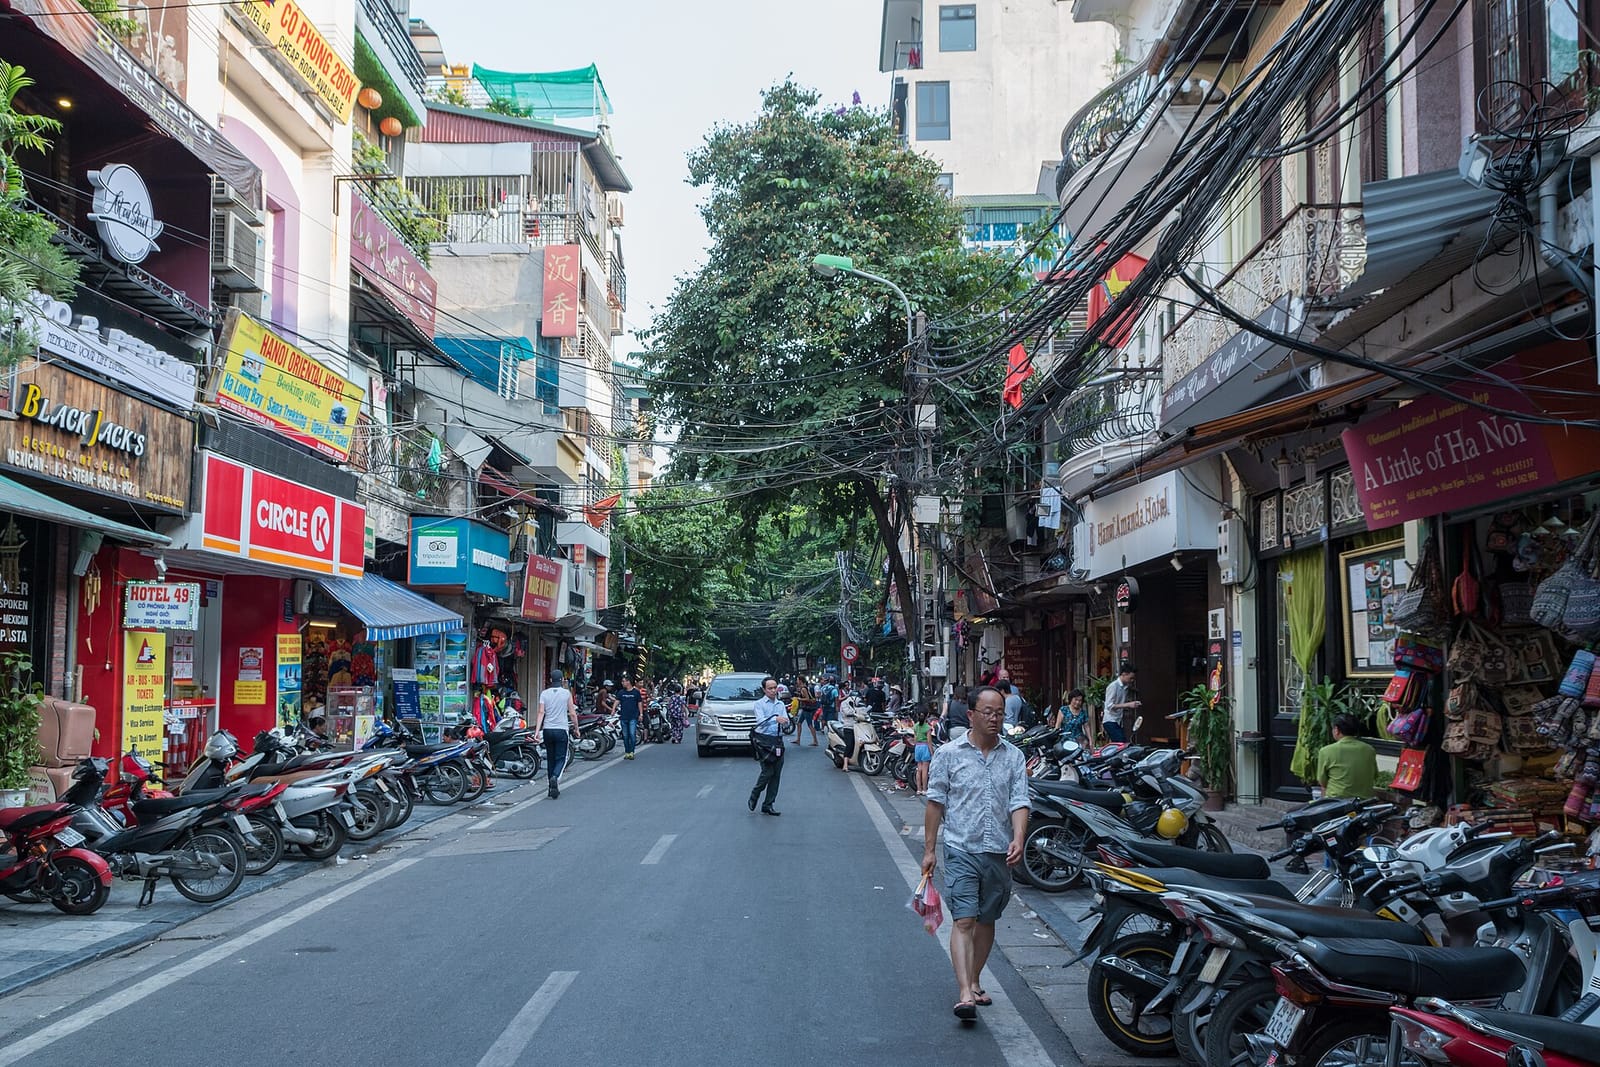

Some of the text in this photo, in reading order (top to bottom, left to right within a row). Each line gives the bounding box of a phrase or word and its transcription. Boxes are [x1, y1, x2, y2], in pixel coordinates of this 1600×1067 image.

[261, 18, 271, 34] 49
[278, 35, 345, 114] CHEAP ROOM AVAILABLE
[330, 62, 357, 103] 260K
[547, 253, 575, 326] 沉香
[260, 334, 345, 402] HANOI ORIENTAL HOTEL
[223, 373, 233, 391] Ha
[234, 380, 251, 401] Long
[250, 386, 264, 408] Bay
[277, 373, 321, 409] Booking office
[21, 383, 146, 457] BLACK JACK'S
[7, 448, 45, 473] MEXICAN
[72, 466, 94, 486] STEAK
[1364, 415, 1527, 491] A Little of Ha Noi
[256, 498, 308, 539] CIRCLE
[1114, 499, 1145, 539] Amanda
[1145, 486, 1171, 525] Hotel
[130, 586, 189, 603] HOTEL 49
[3, 614, 29, 626] MEXICAN
[127, 675, 163, 685] AIR BUS TRAIN
[136, 689, 154, 700] TICKETS
[130, 703, 163, 713] Money Exchange
[139, 720, 154, 728] Service
[144, 733, 157, 743] Airport
[146, 749, 160, 758] Service
